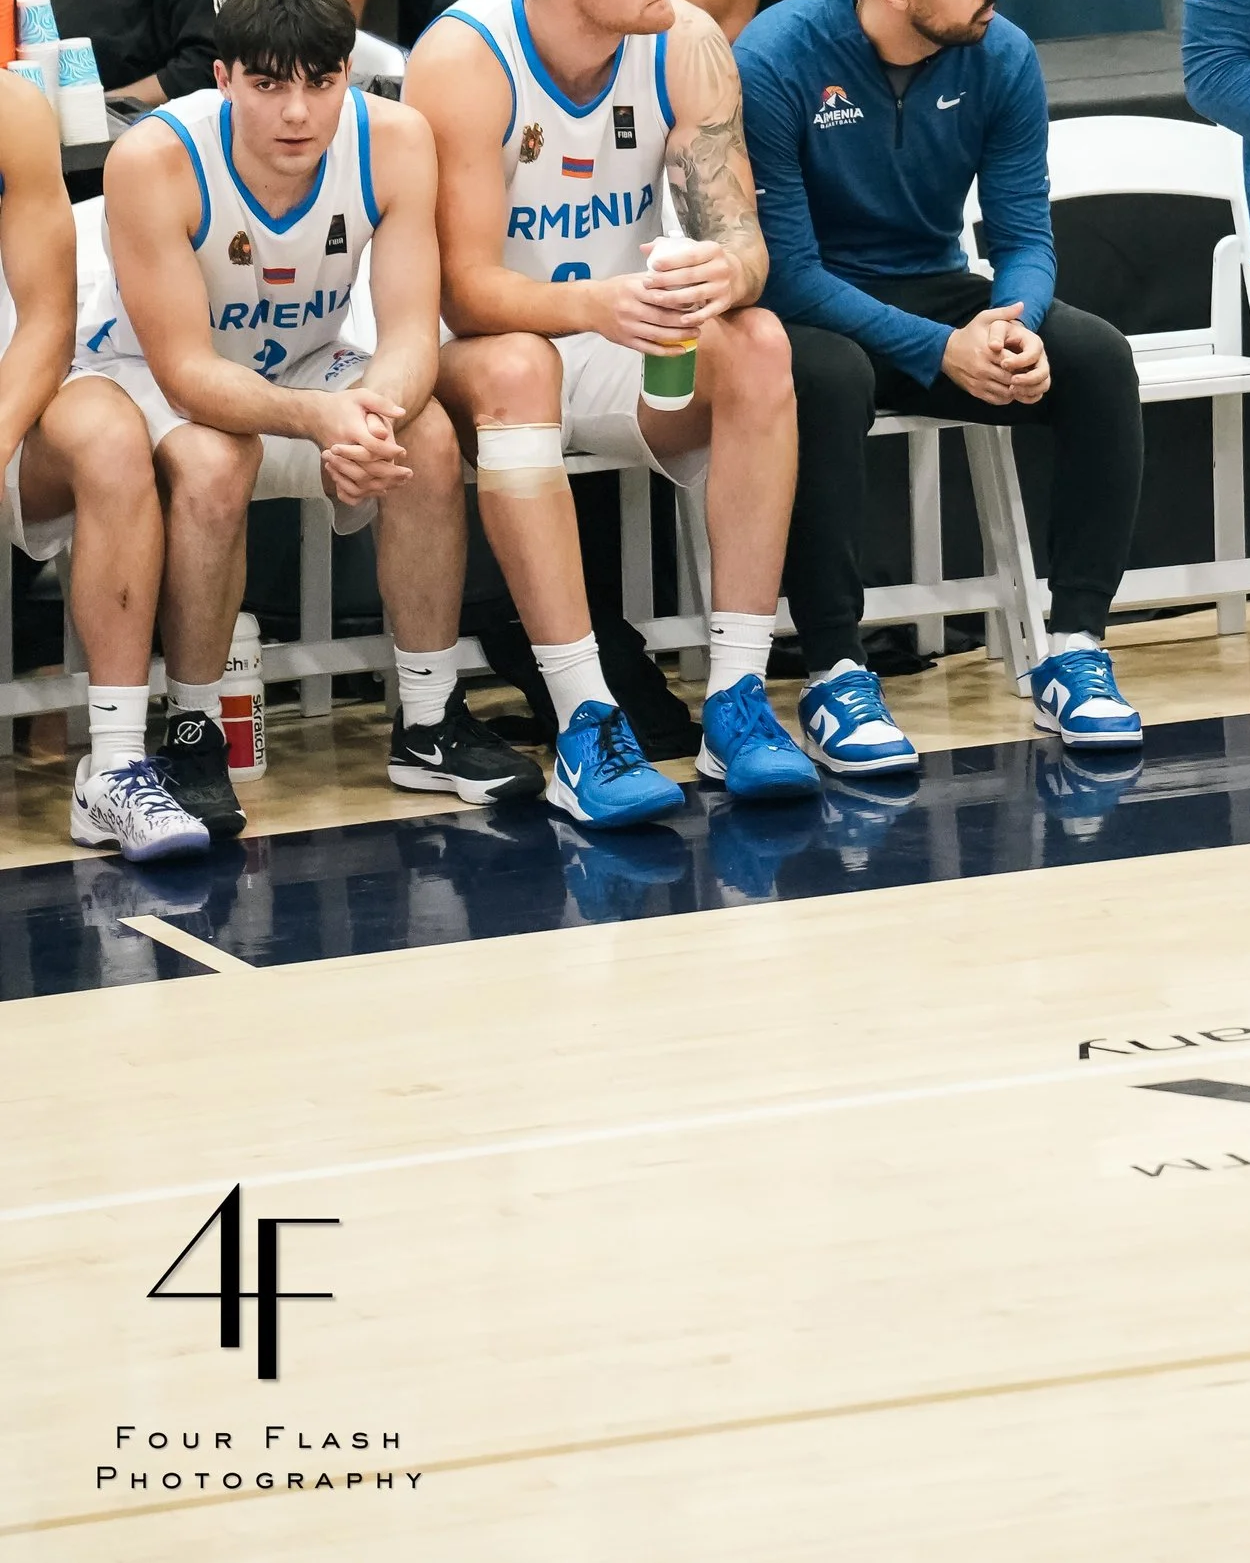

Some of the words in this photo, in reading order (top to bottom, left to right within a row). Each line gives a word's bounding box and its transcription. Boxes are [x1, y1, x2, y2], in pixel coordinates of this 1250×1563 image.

[617, 130, 633, 139] FIBA
[507, 183, 653, 241] RMENIA
[252, 693, 265, 760] skratch
